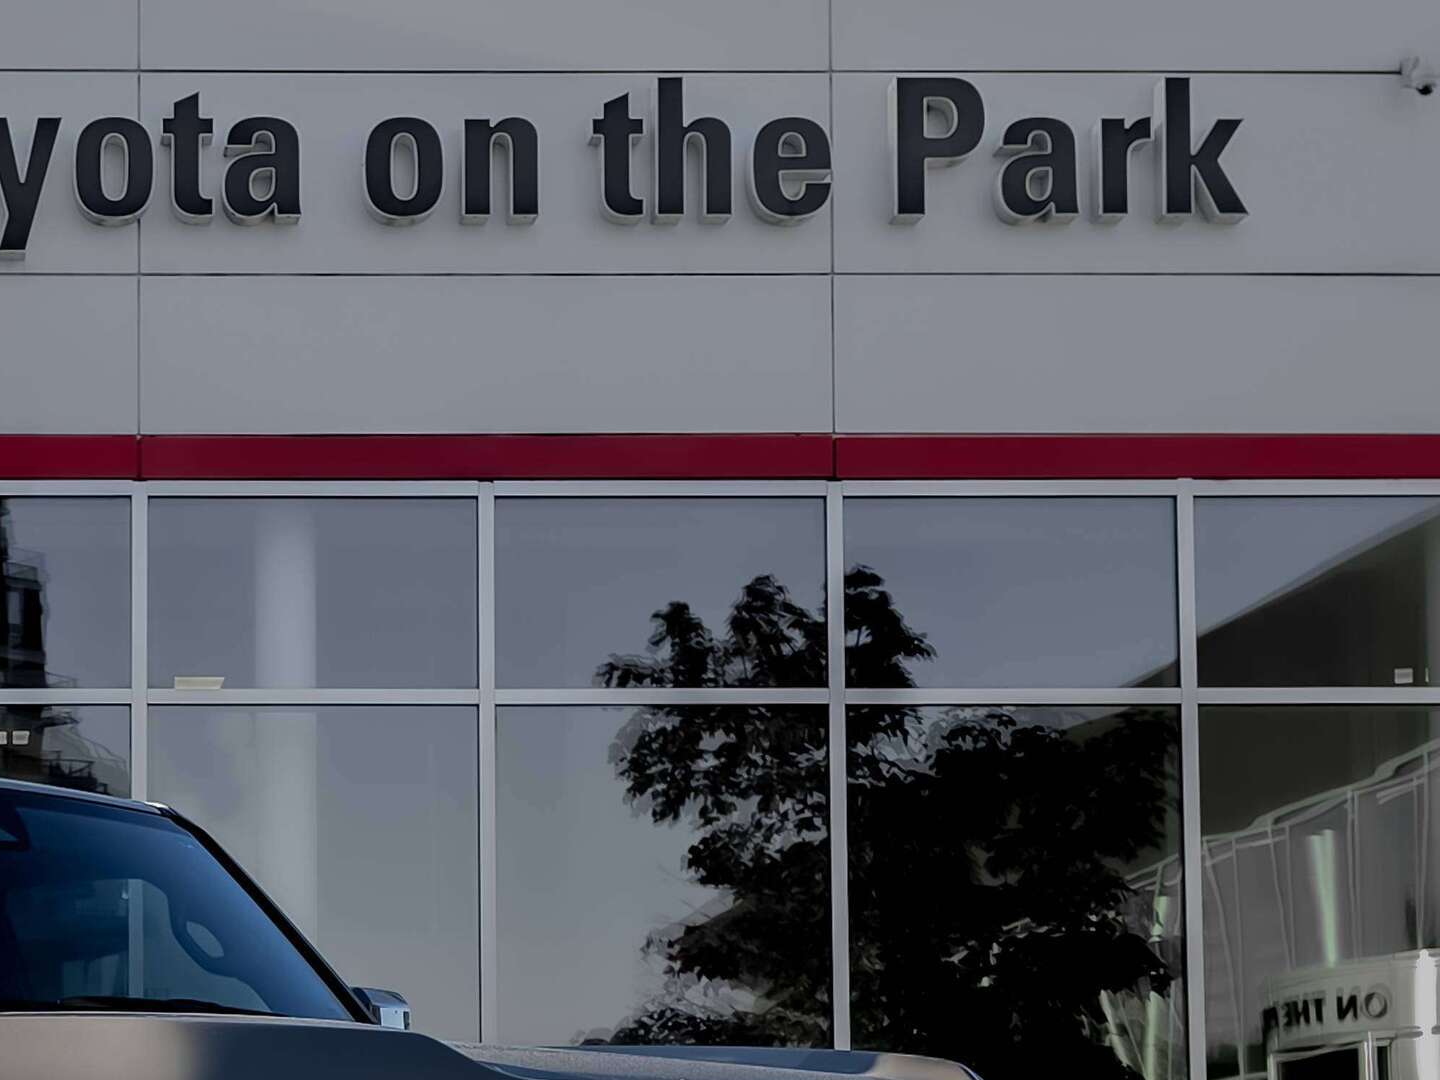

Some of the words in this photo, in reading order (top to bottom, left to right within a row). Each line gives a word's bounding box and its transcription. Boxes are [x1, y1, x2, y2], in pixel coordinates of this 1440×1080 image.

[364, 116, 539, 225] on
[590, 76, 833, 226] the
[890, 76, 1250, 226] Park
